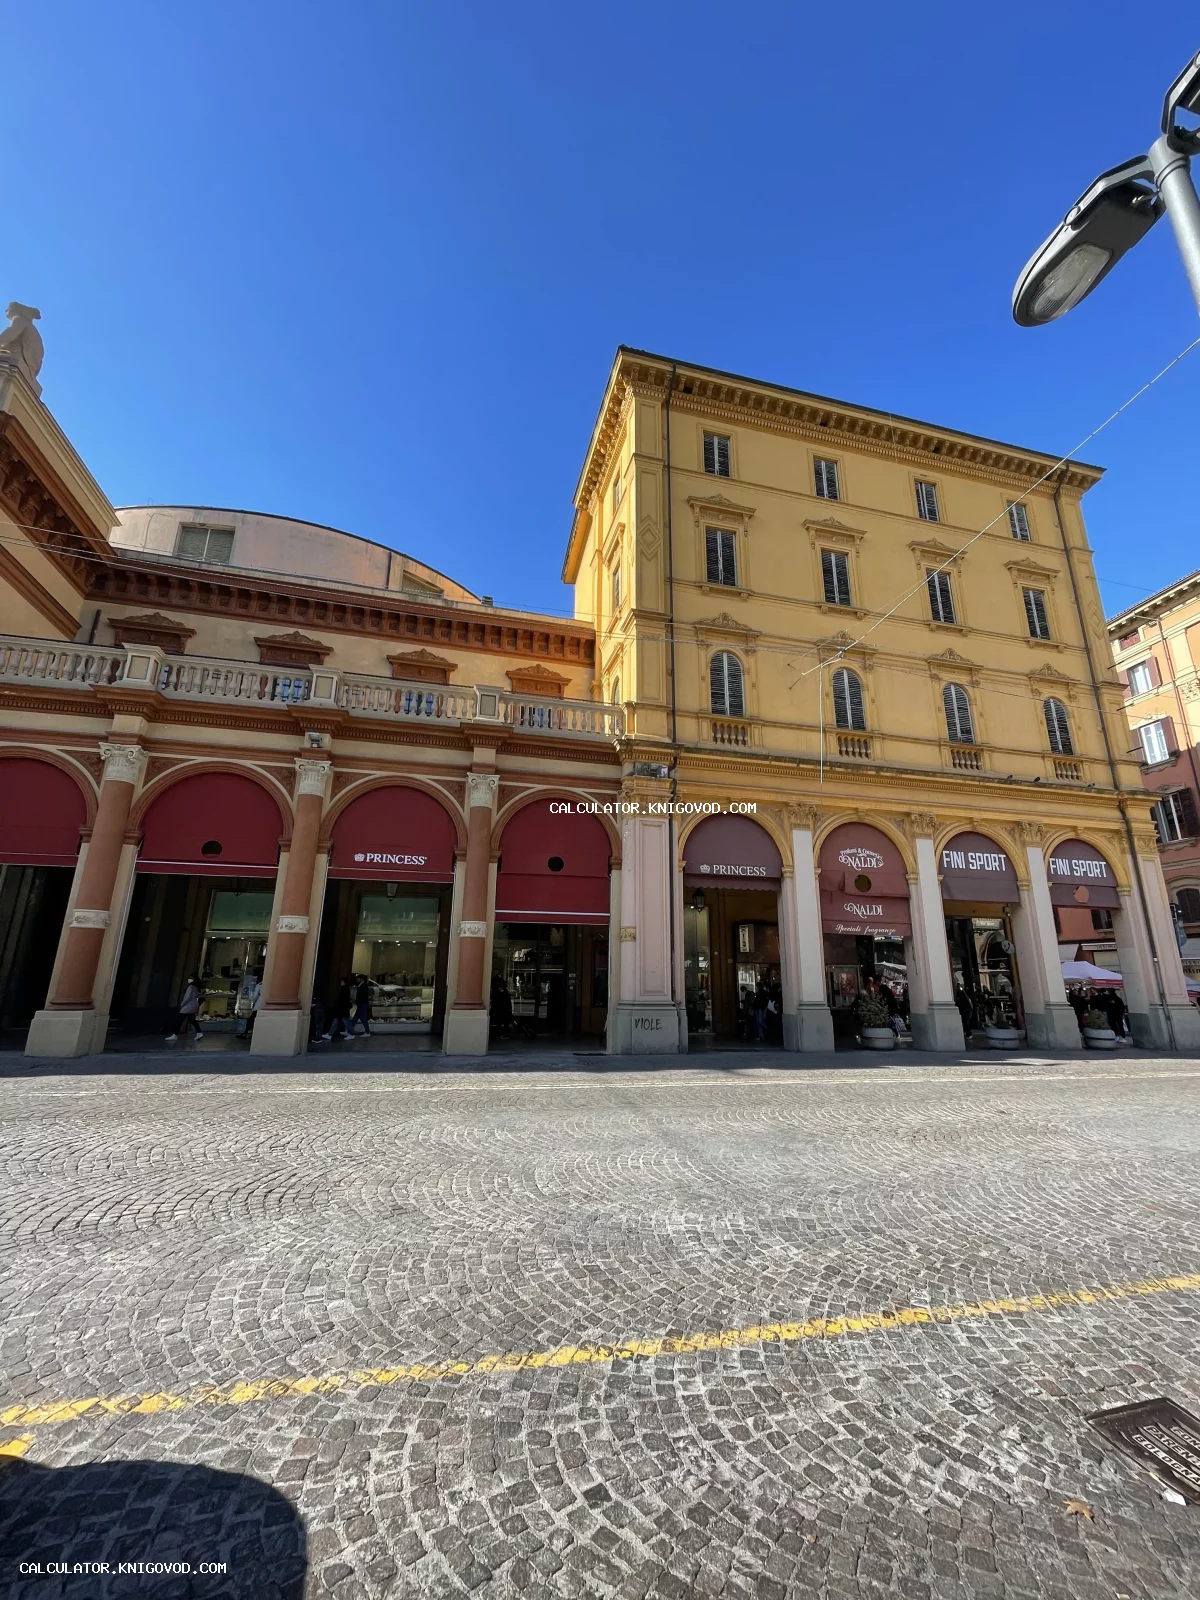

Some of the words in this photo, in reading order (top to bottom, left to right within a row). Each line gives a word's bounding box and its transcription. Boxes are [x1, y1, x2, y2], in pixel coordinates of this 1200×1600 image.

[839, 855, 879, 871] NALDI
[942, 850, 966, 869] FINI
[968, 852, 1006, 872] SPORT
[1049, 858, 1071, 876] FINI
[1072, 860, 1107, 878] SPORT
[713, 864, 766, 877] PRINCESS
[844, 903, 883, 919] NALDI
[634, 1017, 663, 1031] VIOLE
